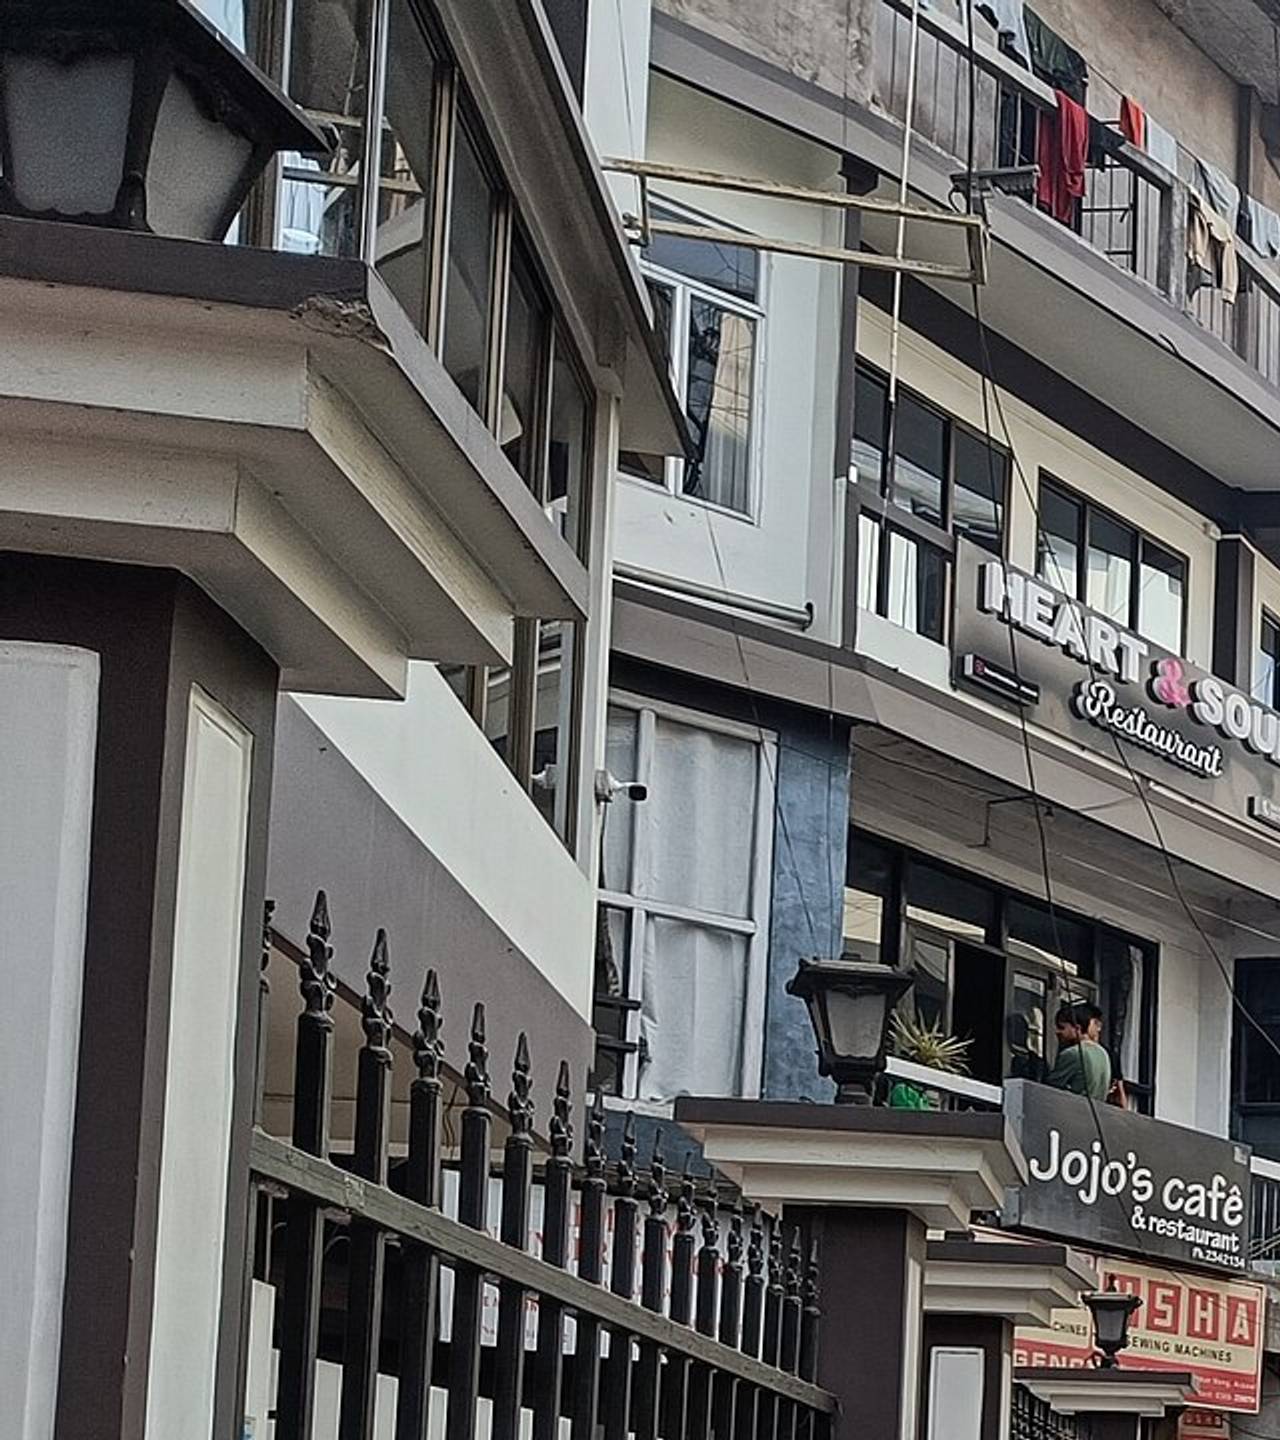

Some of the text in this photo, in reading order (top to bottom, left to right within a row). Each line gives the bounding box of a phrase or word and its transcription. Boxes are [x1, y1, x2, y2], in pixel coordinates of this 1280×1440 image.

[979, 560, 1148, 684] HEART
[1150, 656, 1194, 709] &
[1078, 679, 1224, 778] Restaurant
[1029, 1129, 1154, 1206] Jojo's
[1130, 1204, 1240, 1253] & restaurant
[1053, 1320, 1089, 1338] CHINES
[1113, 1279, 1251, 1342] SHA
[1173, 1342, 1233, 1363] MACHINES
